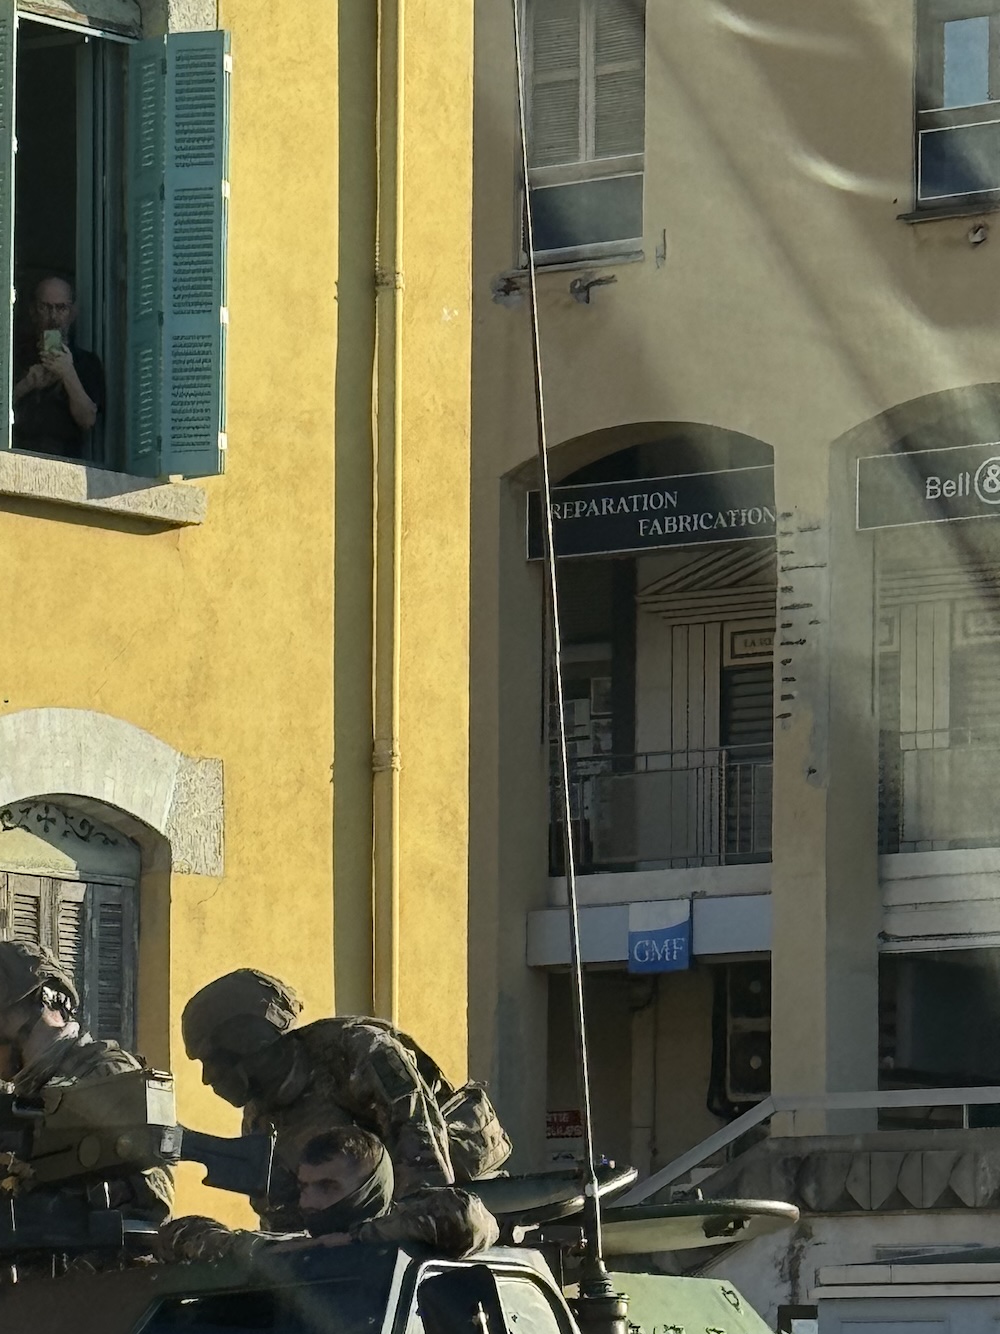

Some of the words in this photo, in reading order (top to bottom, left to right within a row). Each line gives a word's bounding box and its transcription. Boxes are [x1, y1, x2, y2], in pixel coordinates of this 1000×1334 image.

[925, 471, 971, 500] Bell
[551, 490, 678, 521] REPARATION
[639, 505, 776, 537] FABRICATION
[633, 937, 685, 963] GMF
